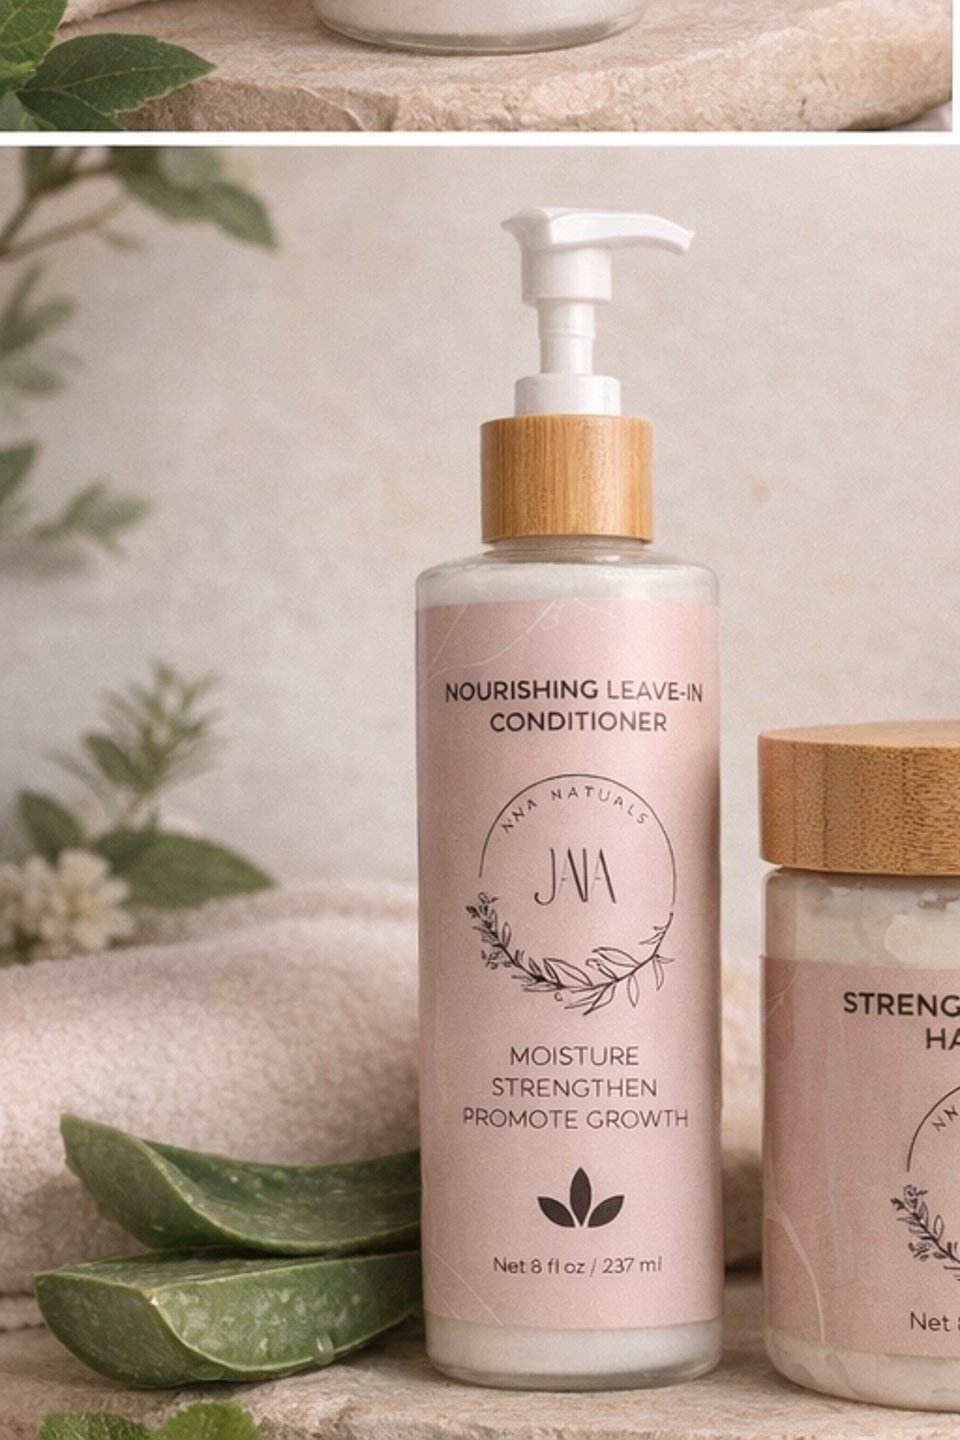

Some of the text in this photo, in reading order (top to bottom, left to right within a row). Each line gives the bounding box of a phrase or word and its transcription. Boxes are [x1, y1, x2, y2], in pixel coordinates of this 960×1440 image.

[446, 679, 702, 702] NOURISHING LEAVE-IN
[490, 711, 666, 732] CONDITIONER
[510, 1046, 639, 1066] MOISTURE
[492, 1077, 656, 1098] STRENGTHEN
[463, 1107, 688, 1129] PROMOTE GROWTH
[494, 1257, 526, 1274] Net
[531, 1258, 542, 1274] 8
[547, 1258, 559, 1274] fl
[564, 1262, 585, 1274] oz
[589, 1258, 597, 1277] /
[602, 1257, 635, 1274] 237
[910, 1312, 950, 1332] Net
